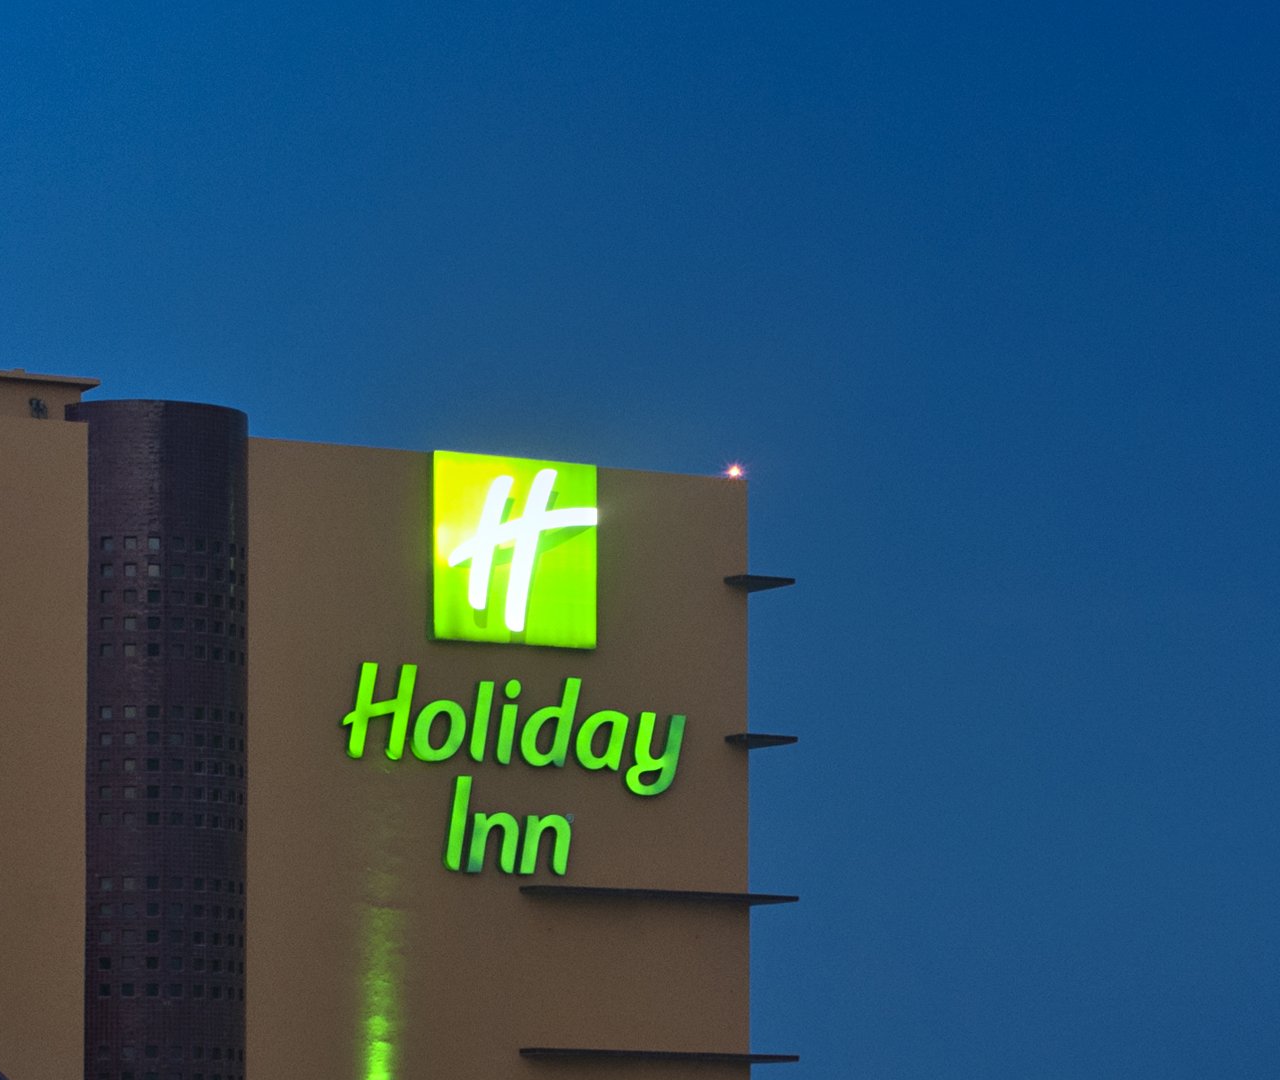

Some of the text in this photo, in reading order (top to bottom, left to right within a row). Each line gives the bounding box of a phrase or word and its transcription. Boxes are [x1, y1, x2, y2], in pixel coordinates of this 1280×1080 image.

[448, 469, 598, 632] H
[341, 661, 687, 796] Holiday
[441, 775, 573, 876] Inn
